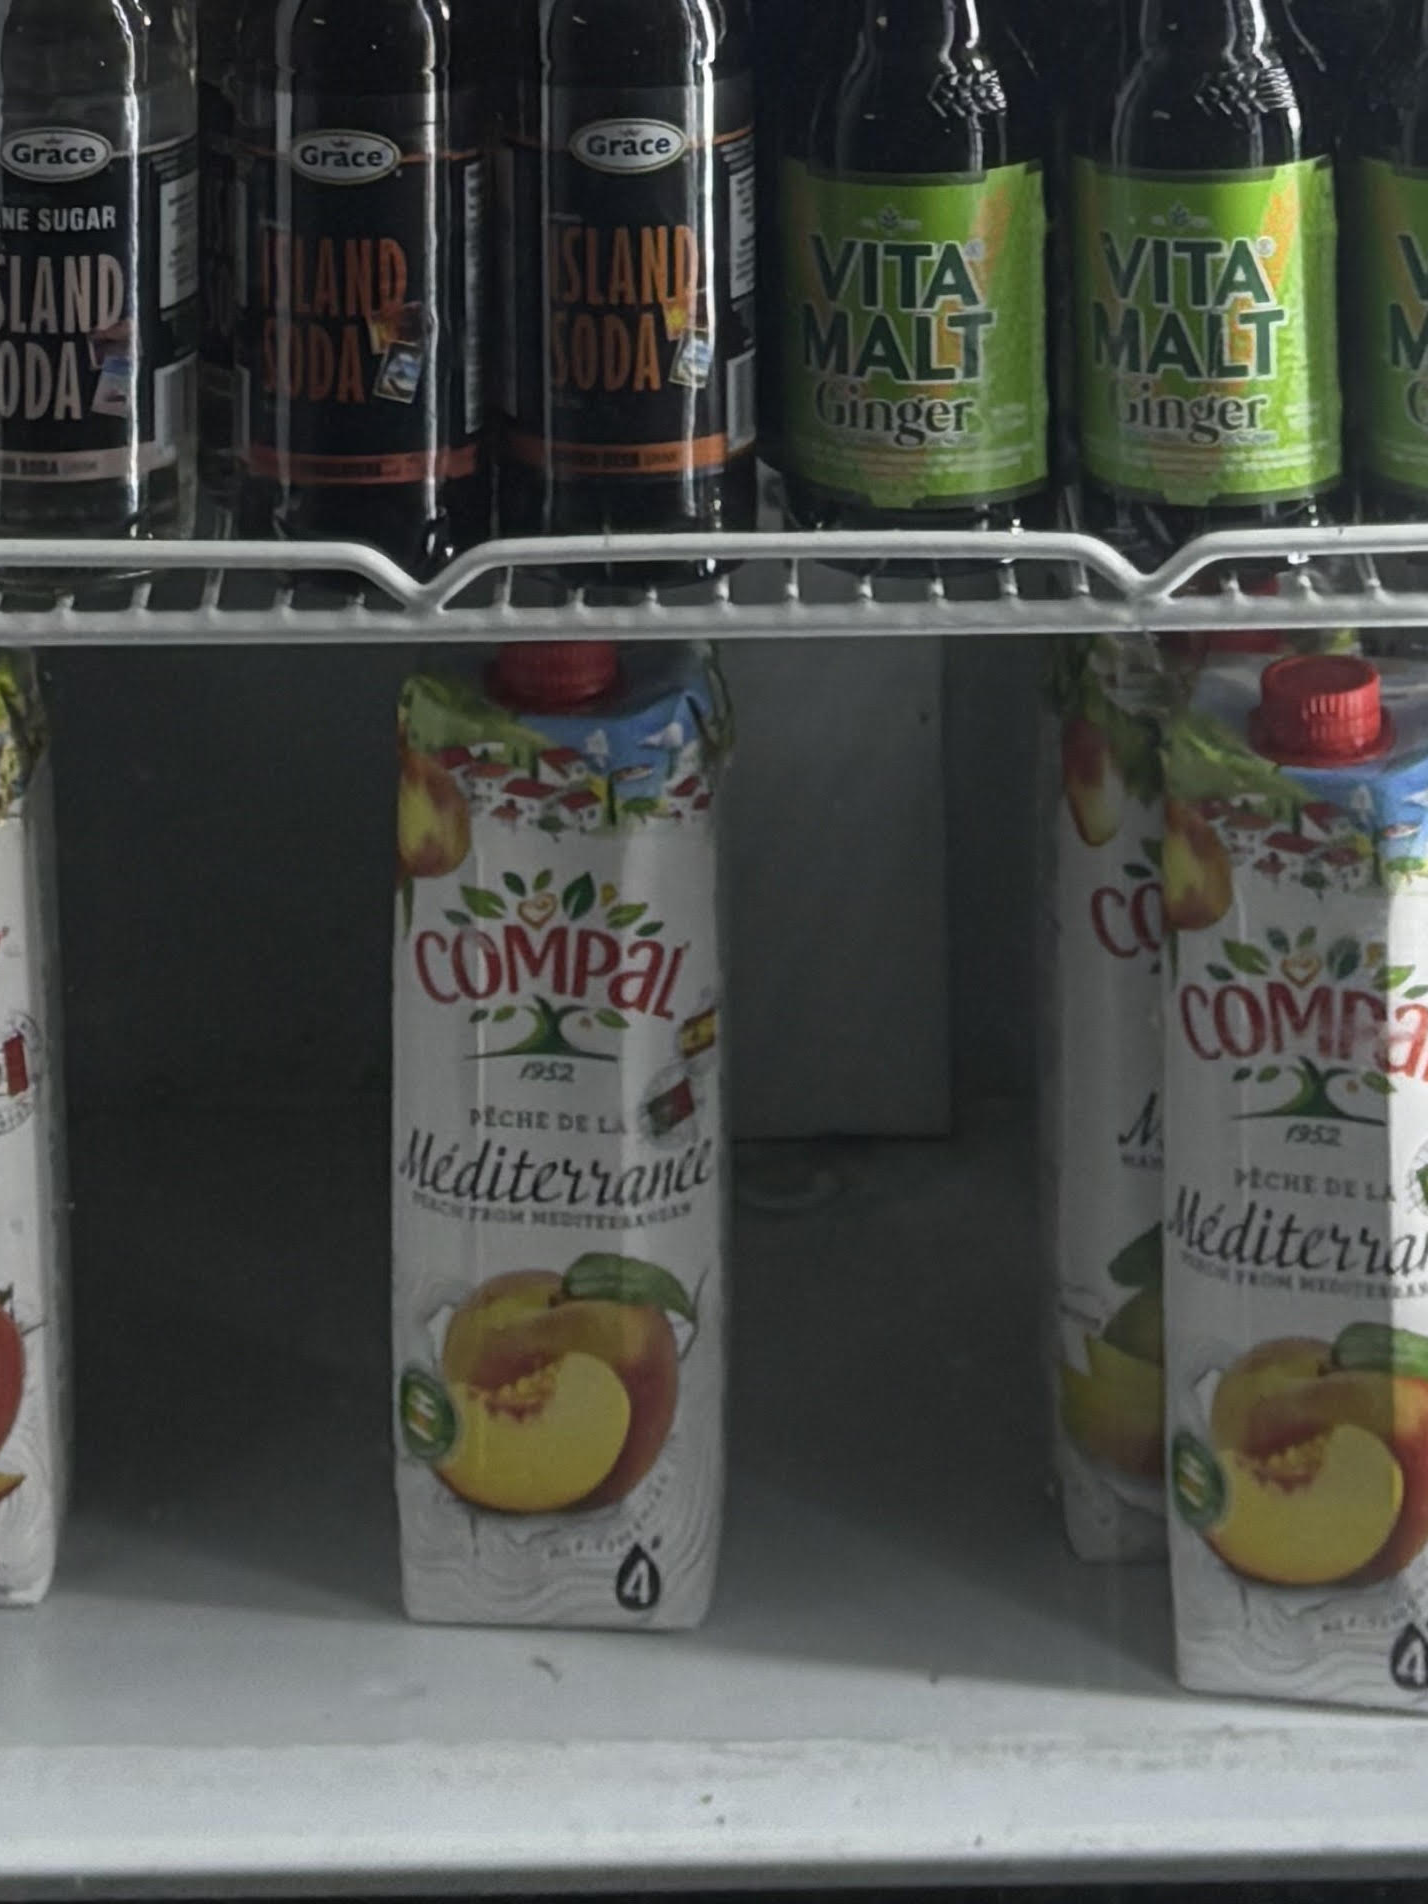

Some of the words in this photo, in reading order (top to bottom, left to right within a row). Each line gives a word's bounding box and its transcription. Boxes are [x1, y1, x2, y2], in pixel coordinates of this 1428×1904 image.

[11, 143, 96, 165] Grace
[300, 144, 383, 168] Grace
[586, 135, 671, 157] Grace
[36, 204, 118, 233] SUGAR
[549, 223, 699, 305] ISLAND
[811, 235, 980, 310] VITA
[1099, 231, 1271, 307] VITA
[551, 310, 662, 392] SODA
[802, 304, 995, 380] MALT
[1092, 300, 1285, 378] MALT
[817, 381, 976, 447] Ginger
[518, 1061, 576, 1084] 1952
[558, 1112, 590, 1133] DE
[1284, 1123, 1344, 1147] 1952
[1324, 1176, 1356, 1198] DE
